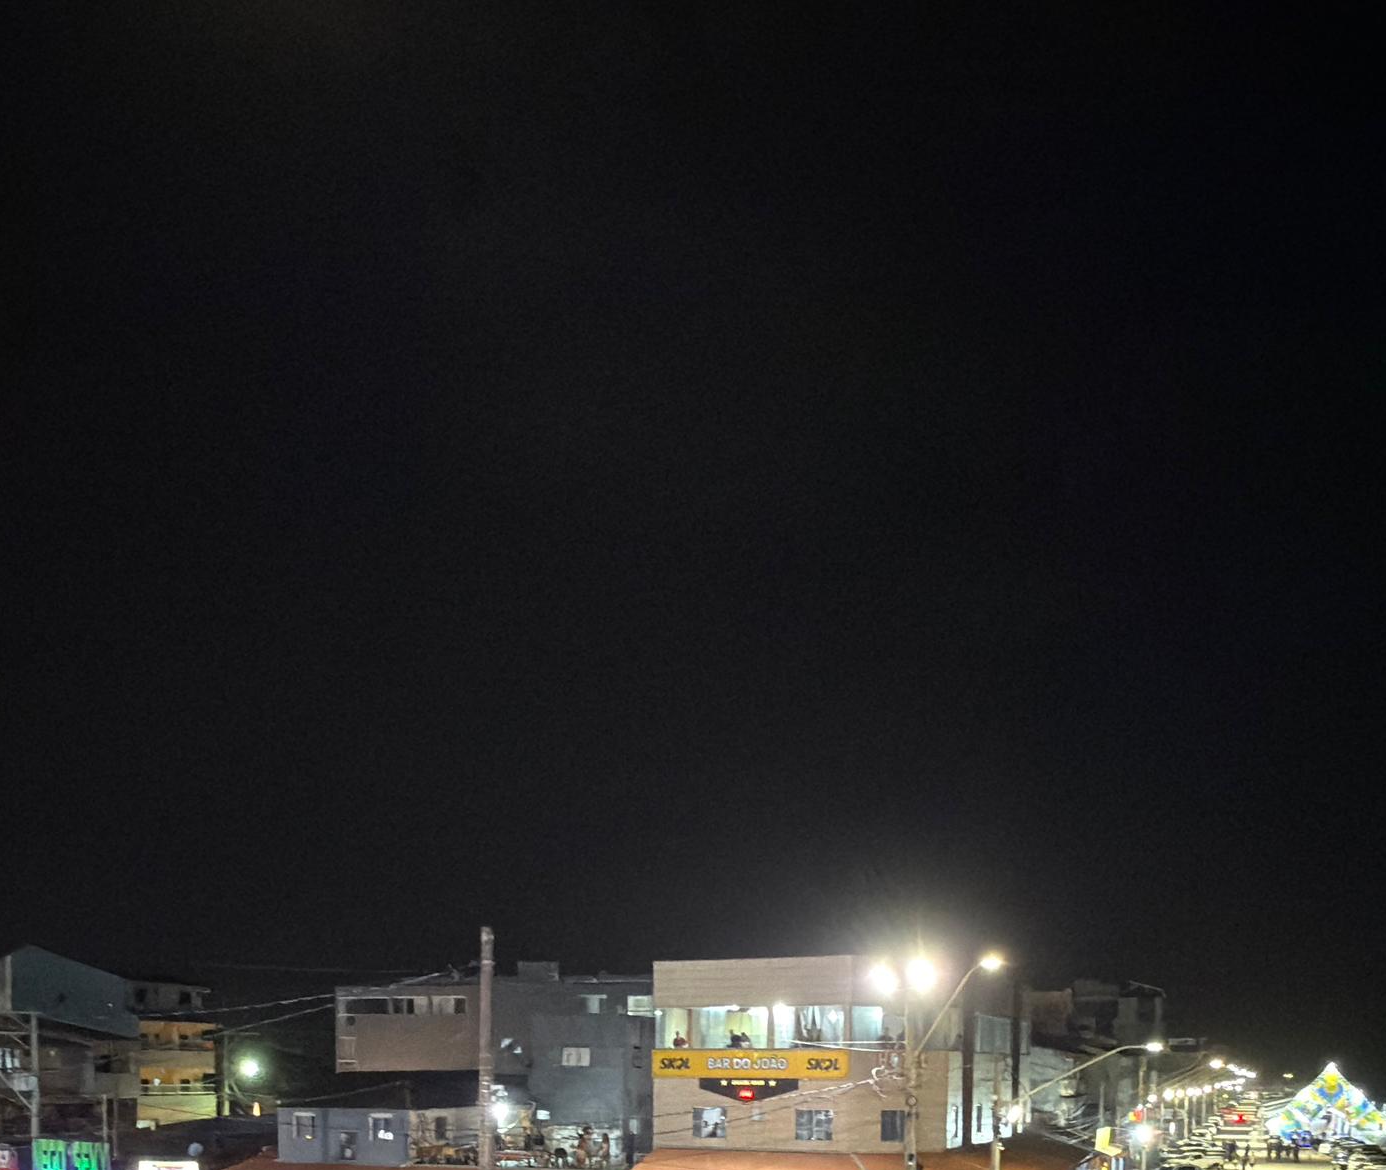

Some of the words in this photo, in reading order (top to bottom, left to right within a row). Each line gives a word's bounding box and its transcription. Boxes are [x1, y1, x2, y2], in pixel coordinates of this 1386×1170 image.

[660, 1058, 691, 1070] SKOL
[708, 1058, 730, 1069] BAR
[733, 1058, 751, 1069] DO
[753, 1055, 788, 1069] JOÃO
[806, 1058, 841, 1071] SKOL
